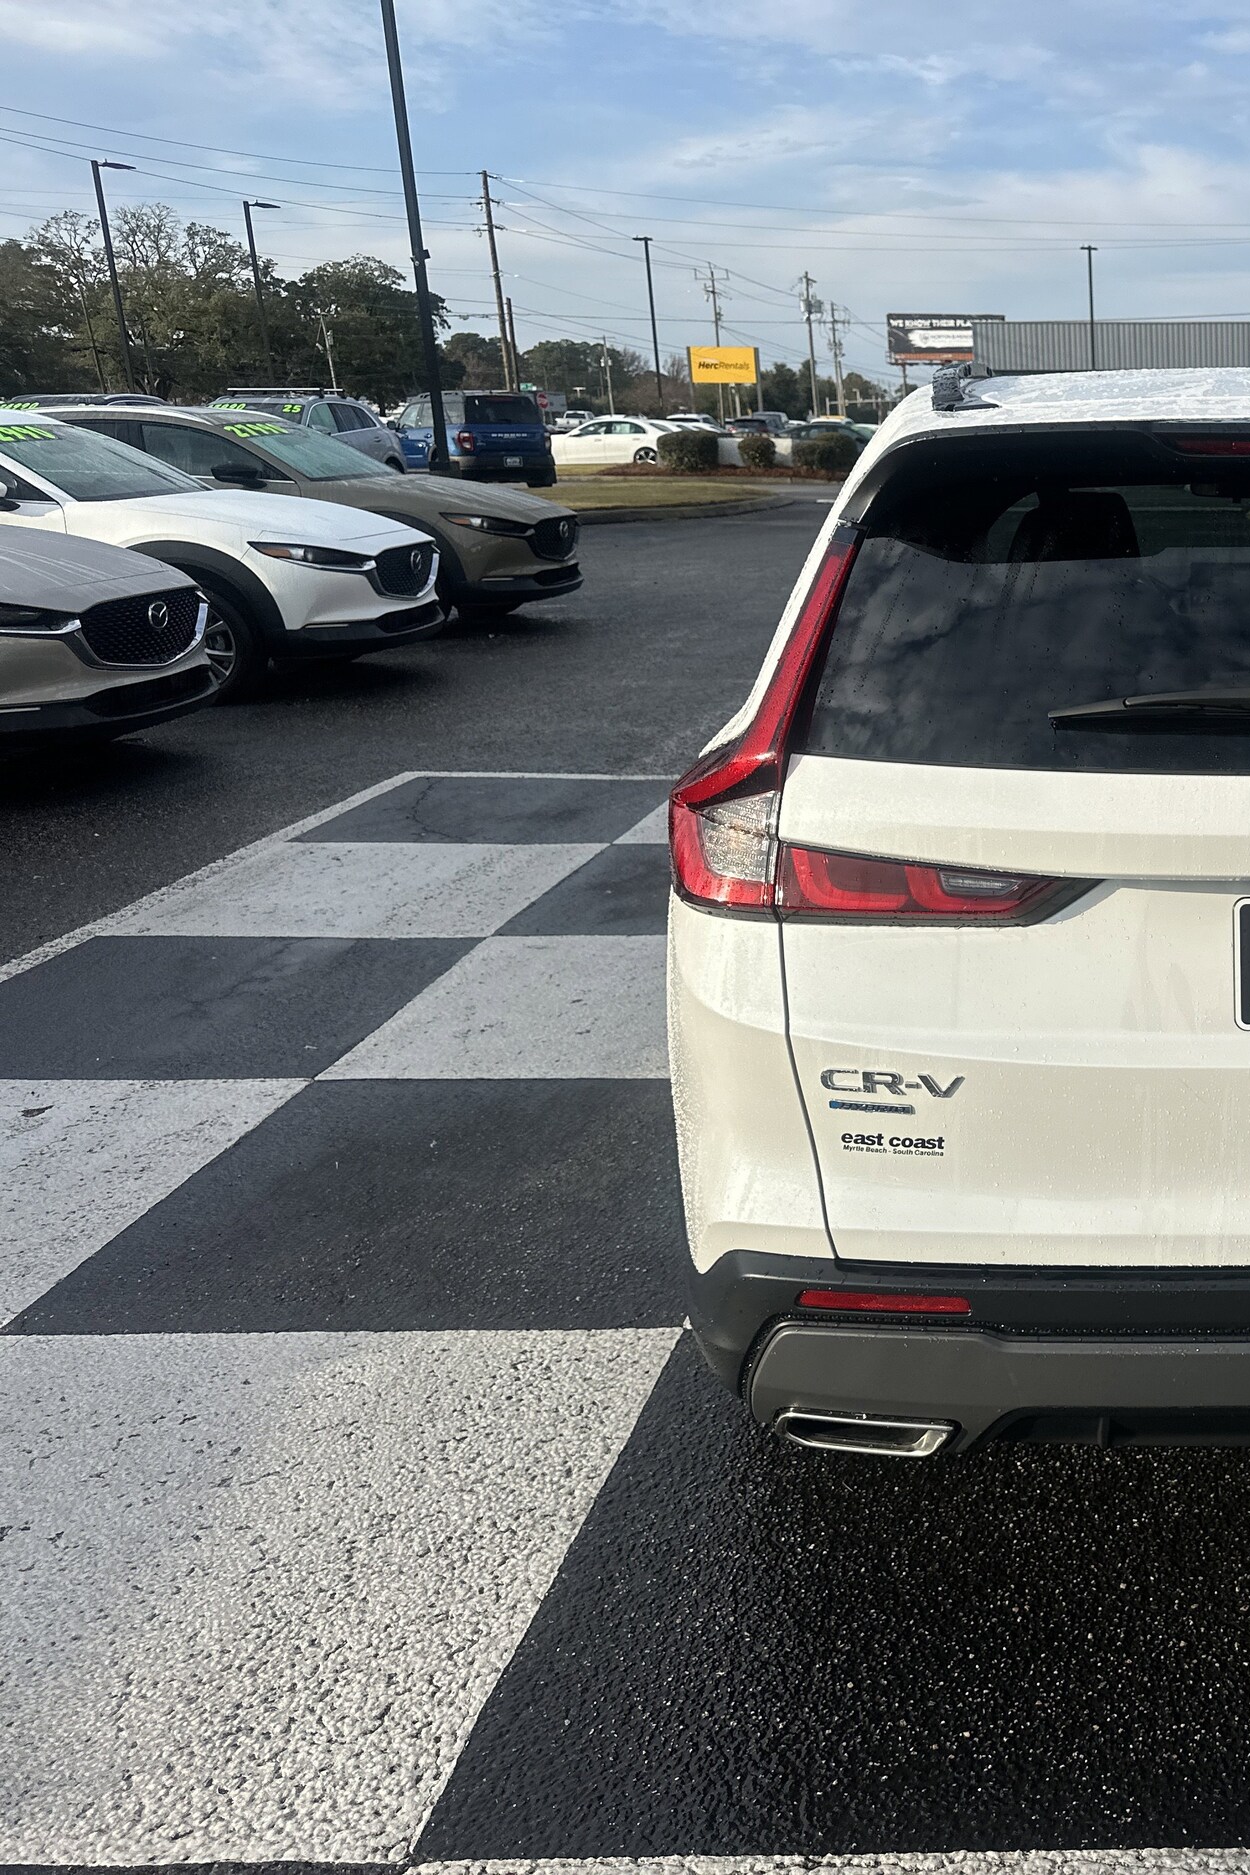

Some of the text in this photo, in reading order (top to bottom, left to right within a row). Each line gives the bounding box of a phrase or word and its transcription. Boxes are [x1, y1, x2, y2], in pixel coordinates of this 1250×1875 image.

[282, 404, 302, 413] 25
[820, 1068, 966, 1098] CR-V
[841, 1132, 945, 1149] east coast
[843, 1144, 864, 1152] Myrtle
[865, 1146, 887, 1154] Beach
[914, 1149, 944, 1157] Carolina
